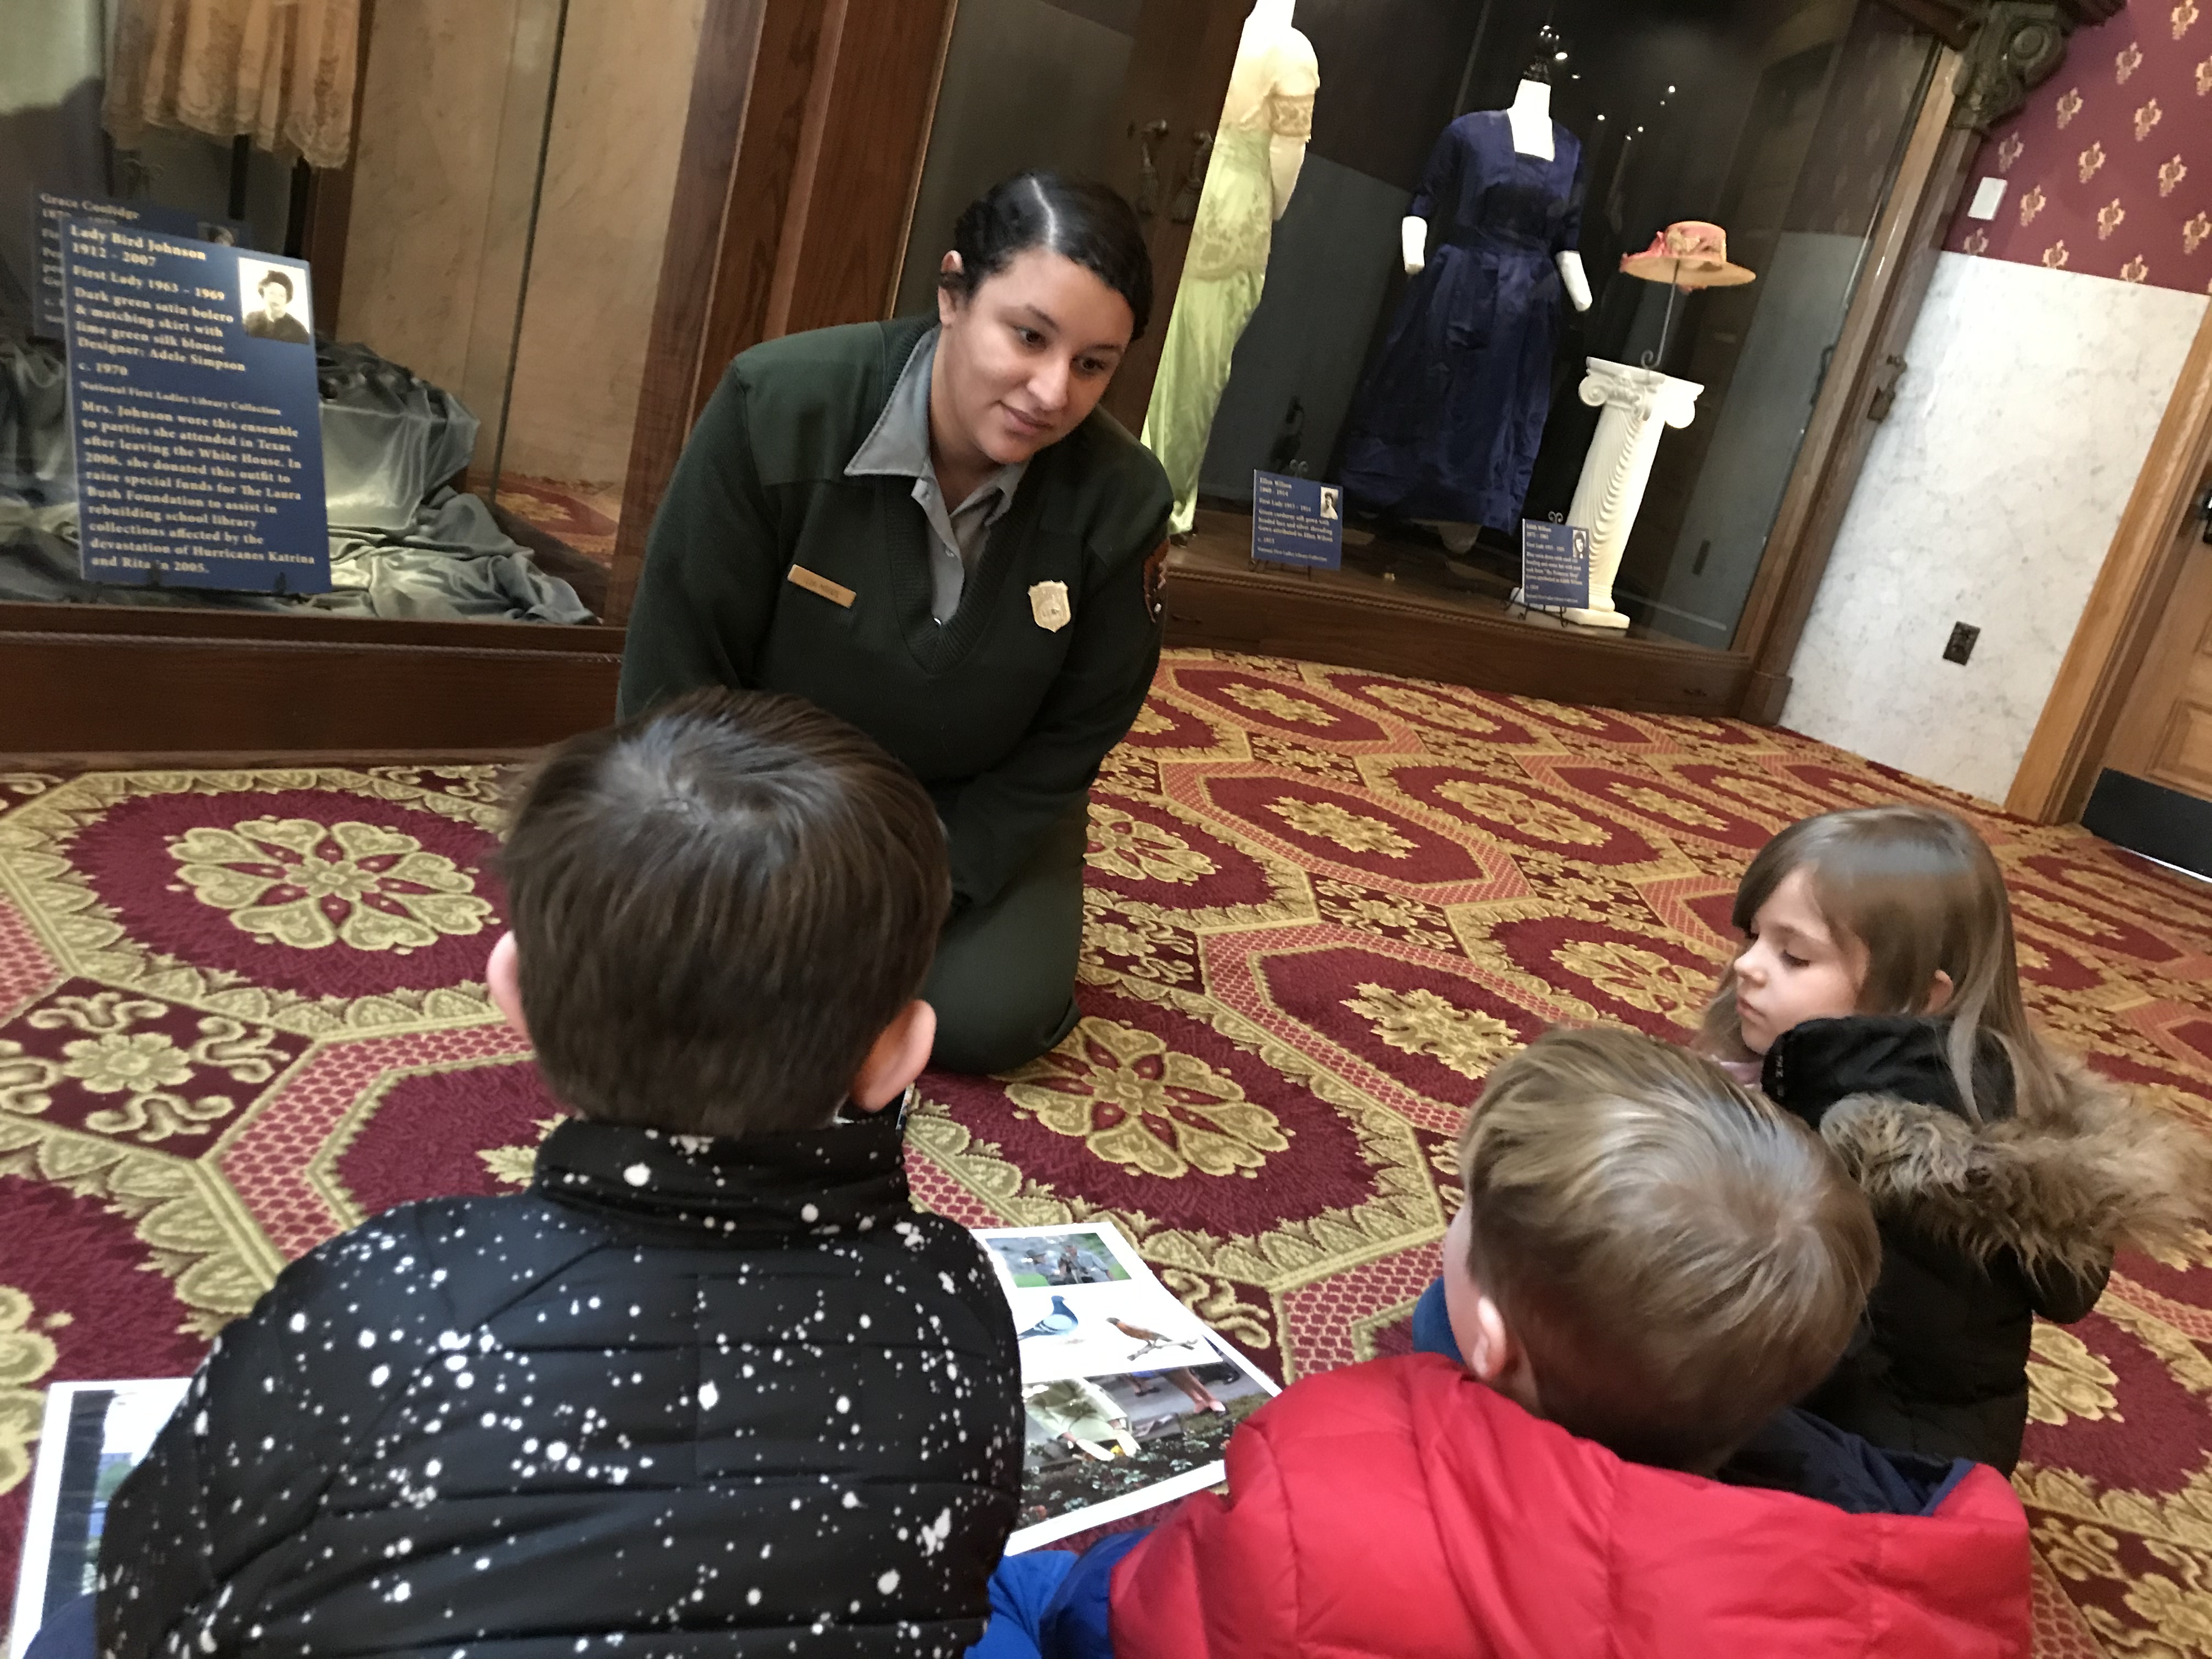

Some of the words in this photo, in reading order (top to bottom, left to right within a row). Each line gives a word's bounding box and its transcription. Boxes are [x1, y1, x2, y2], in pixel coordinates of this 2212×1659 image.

[70, 224, 107, 243] Lady
[110, 232, 144, 248] Bird
[148, 239, 206, 261] Johnson
[72, 242, 106, 258] 1912
[122, 251, 156, 267] 2007
[72, 265, 106, 281] First
[110, 271, 144, 289] Lady
[194, 287, 225, 301] 1969
[74, 286, 109, 302] Dark
[112, 296, 152, 309] green
[155, 303, 188, 315] satin
[190, 306, 234, 323] bolero
[75, 304, 87, 315] &
[89, 309, 155, 328] matching
[158, 318, 190, 332] skirt
[194, 325, 223, 337] with
[111, 329, 149, 341] green
[153, 335, 178, 346] silk
[181, 337, 224, 354] blouse
[149, 348, 187, 363] Adele
[190, 354, 246, 371] Simpson
[80, 381, 127, 394] National
[127, 387, 154, 398] First
[155, 391, 190, 403] Ladies
[190, 396, 229, 409] Library
[230, 401, 281, 415] Collection
[81, 400, 113, 414] Mrs.
[117, 405, 173, 422] Johnson
[176, 415, 209, 426] wore
[211, 417, 238, 430] this
[239, 424, 299, 437] ensemble
[82, 419, 98, 428] to
[100, 422, 150, 435] parties
[153, 427, 176, 438] she
[179, 432, 236, 445] attended
[240, 438, 253, 448] in
[257, 439, 291, 452] Texas
[83, 436, 115, 448] after
[119, 438, 170, 456] leaving
[173, 446, 195, 457] the
[198, 448, 238, 462] White
[241, 453, 284, 467] House.
[287, 458, 302, 469] In
[126, 456, 149, 469] she
[153, 460, 207, 475] donated
[210, 466, 236, 477] this
[239, 471, 274, 482] outfit
[277, 474, 291, 483] to
[86, 471, 120, 482] raise
[123, 476, 172, 487] special
[175, 478, 213, 491] funds
[216, 483, 236, 494] for
[240, 485, 262, 496] The
[265, 488, 301, 500] Laura
[87, 486, 121, 499] Bush
[126, 490, 205, 507] Foundation
[207, 499, 222, 509] to
[224, 502, 261, 512] assist
[263, 504, 278, 514] in
[88, 504, 162, 522] rebuilding
[165, 511, 208, 523] school
[212, 514, 257, 530] library
[88, 522, 166, 536] collections
[168, 528, 221, 541] affected
[224, 532, 239, 543] by
[242, 533, 264, 544] the
[89, 538, 171, 554] devastation
[173, 545, 188, 555] of
[193, 546, 265, 561] Hurricanes
[268, 551, 315, 564] Katrina
[91, 556, 118, 567] and
